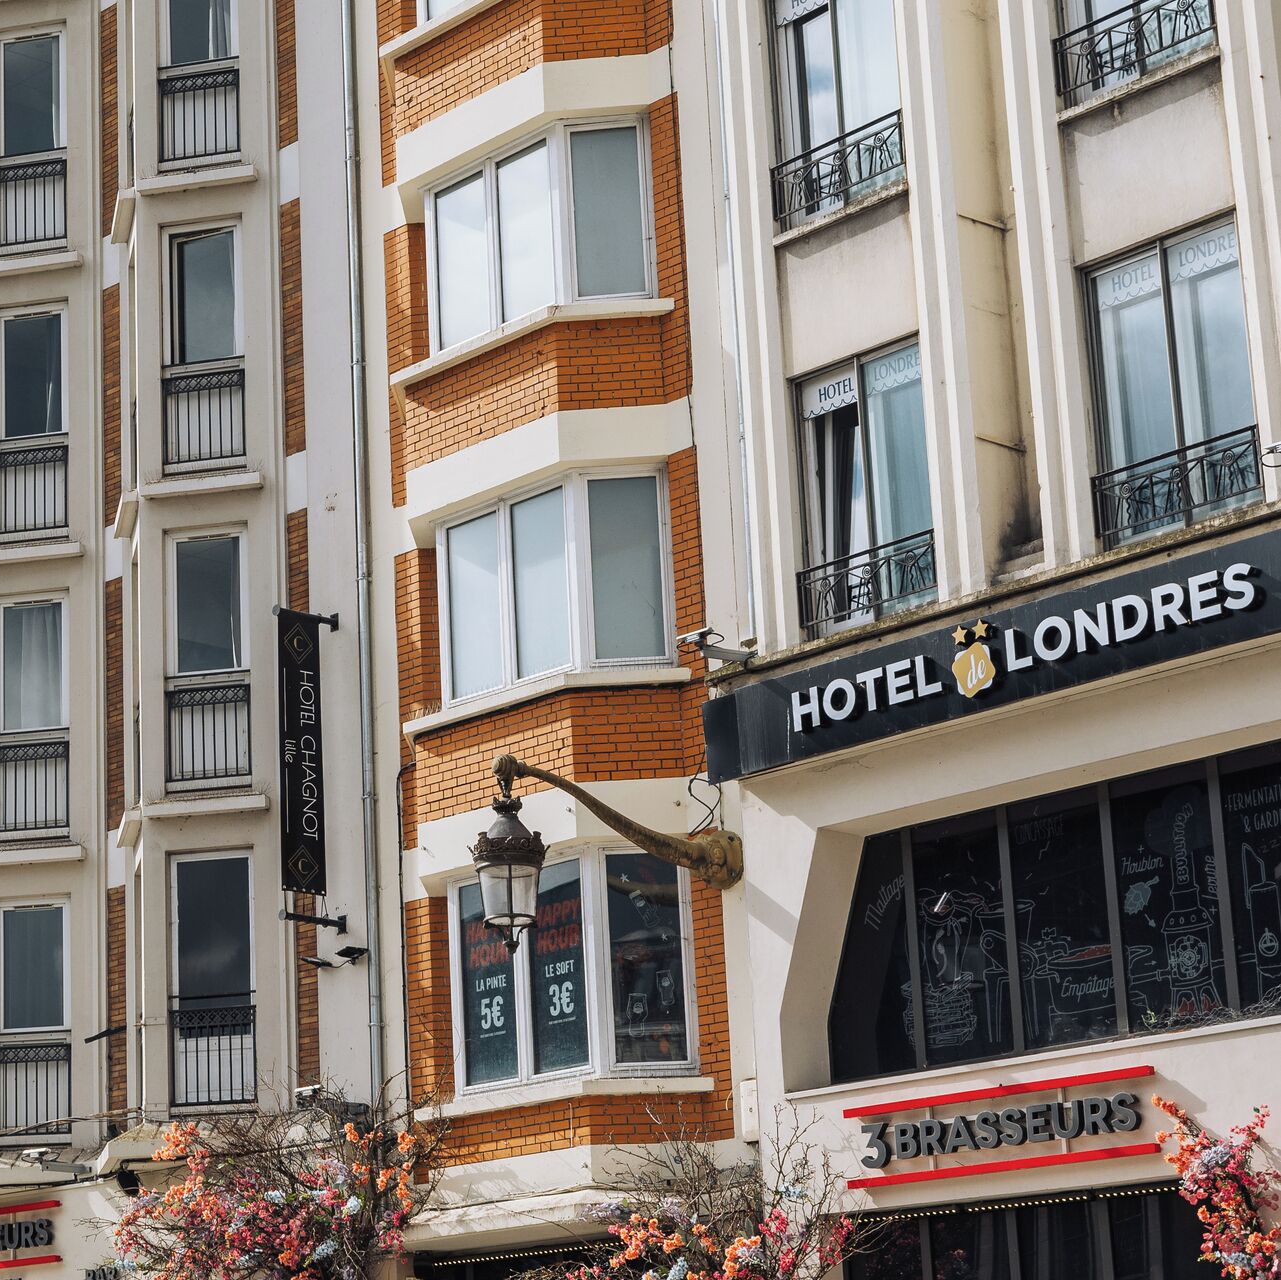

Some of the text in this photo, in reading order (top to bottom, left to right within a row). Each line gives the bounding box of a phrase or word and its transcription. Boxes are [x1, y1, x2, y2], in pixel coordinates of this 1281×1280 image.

[1111, 231, 1235, 293] HOTEL LONDRE
[818, 352, 920, 403] HOTEL LONDRE
[791, 562, 1256, 733] HOTEL de LONDRES
[284, 739, 296, 764] lille
[299, 669, 318, 841] HOTEL CHAGNOT
[1228, 784, 1281, 812] FERMENTATI
[1254, 808, 1281, 831] GARD
[1122, 855, 1164, 876] Houblon
[864, 873, 904, 931] Maltage
[476, 974, 507, 992] LA PINTE
[545, 959, 575, 978] LE SOFT
[480, 995, 504, 1030] 5€
[548, 981, 574, 1017] 3€
